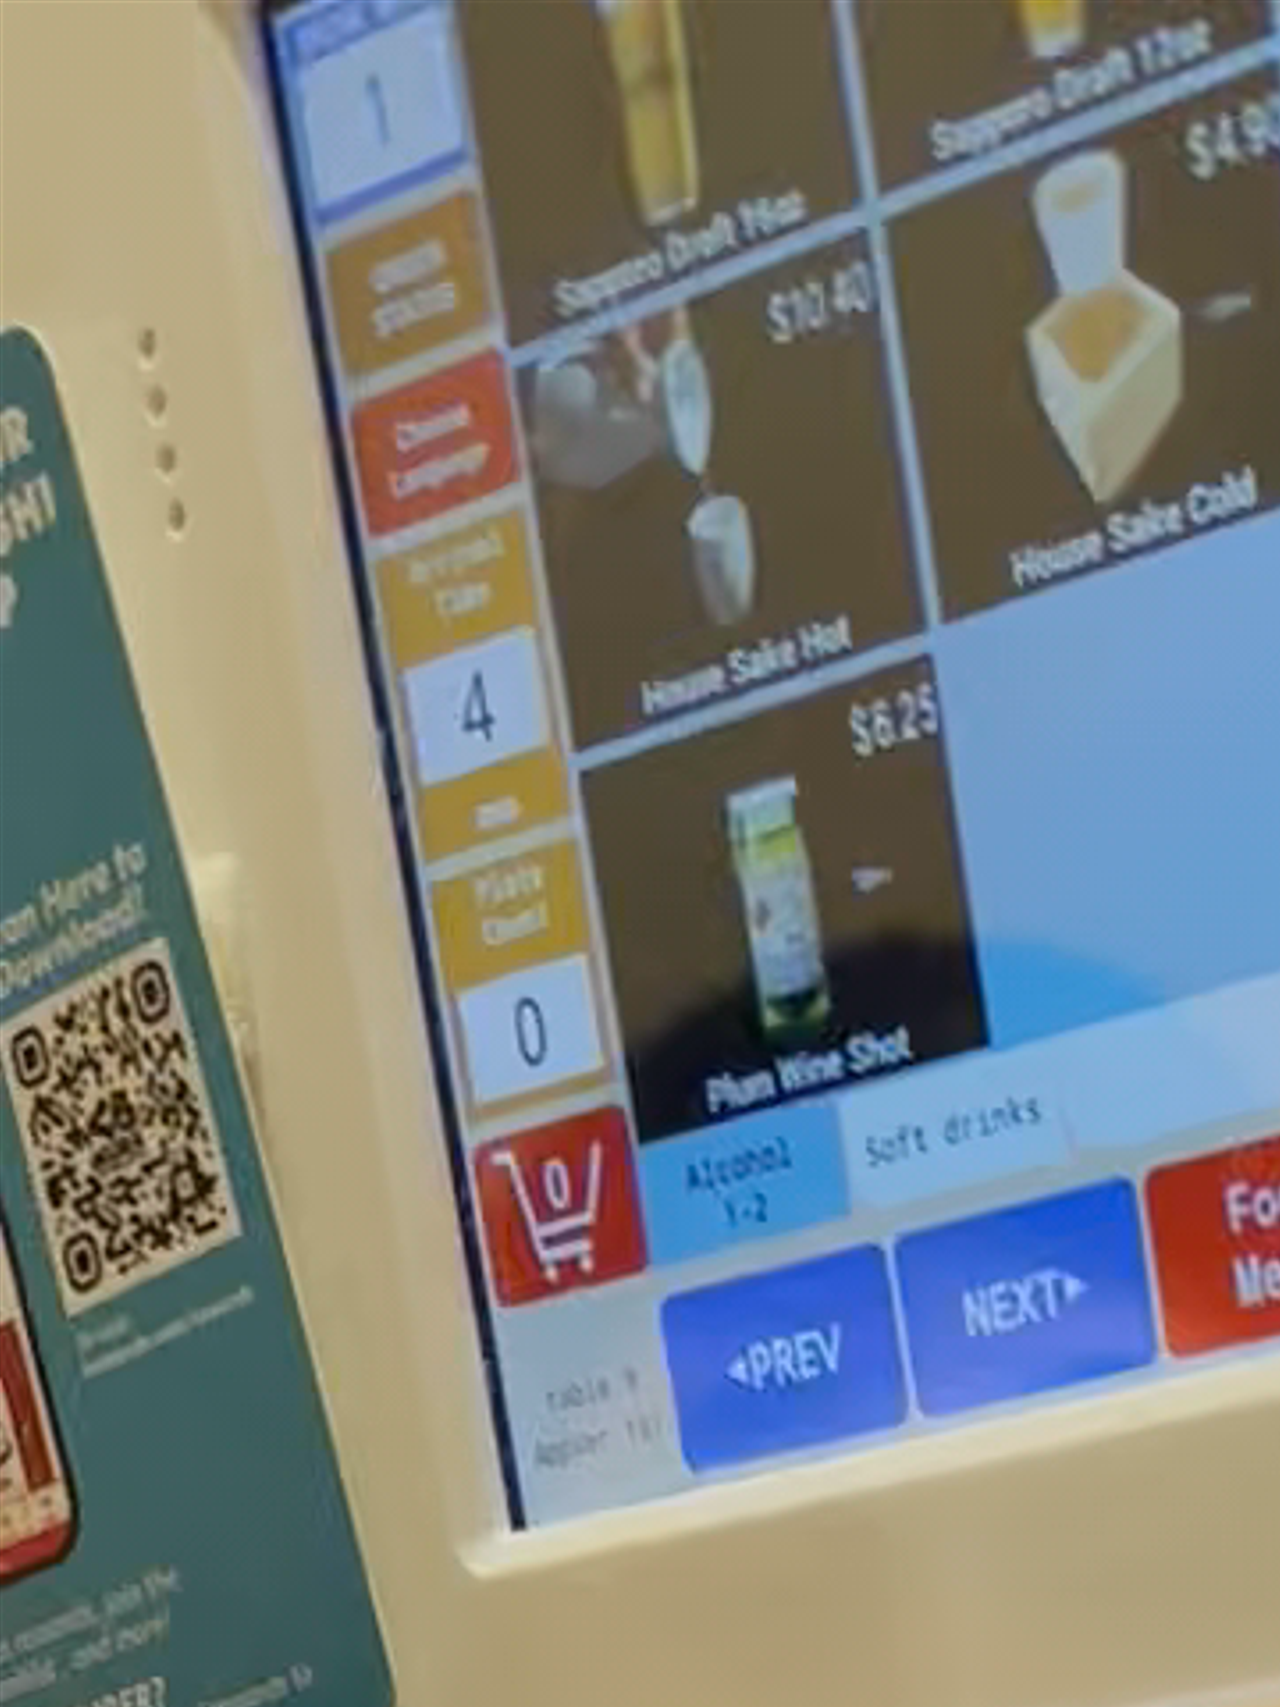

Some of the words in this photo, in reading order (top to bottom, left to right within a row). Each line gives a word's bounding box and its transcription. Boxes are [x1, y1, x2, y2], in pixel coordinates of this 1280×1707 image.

[1107, 499, 1184, 553] Sake
[461, 669, 495, 742] 4
[850, 682, 938, 757] $6.25
[515, 997, 548, 1067] 0
[865, 1124, 929, 1169] Soft
[943, 1096, 1044, 1146] drinks
[546, 1158, 571, 1209] 0
[962, 1269, 1063, 1337] NEXT
[750, 1321, 841, 1391] PREV
